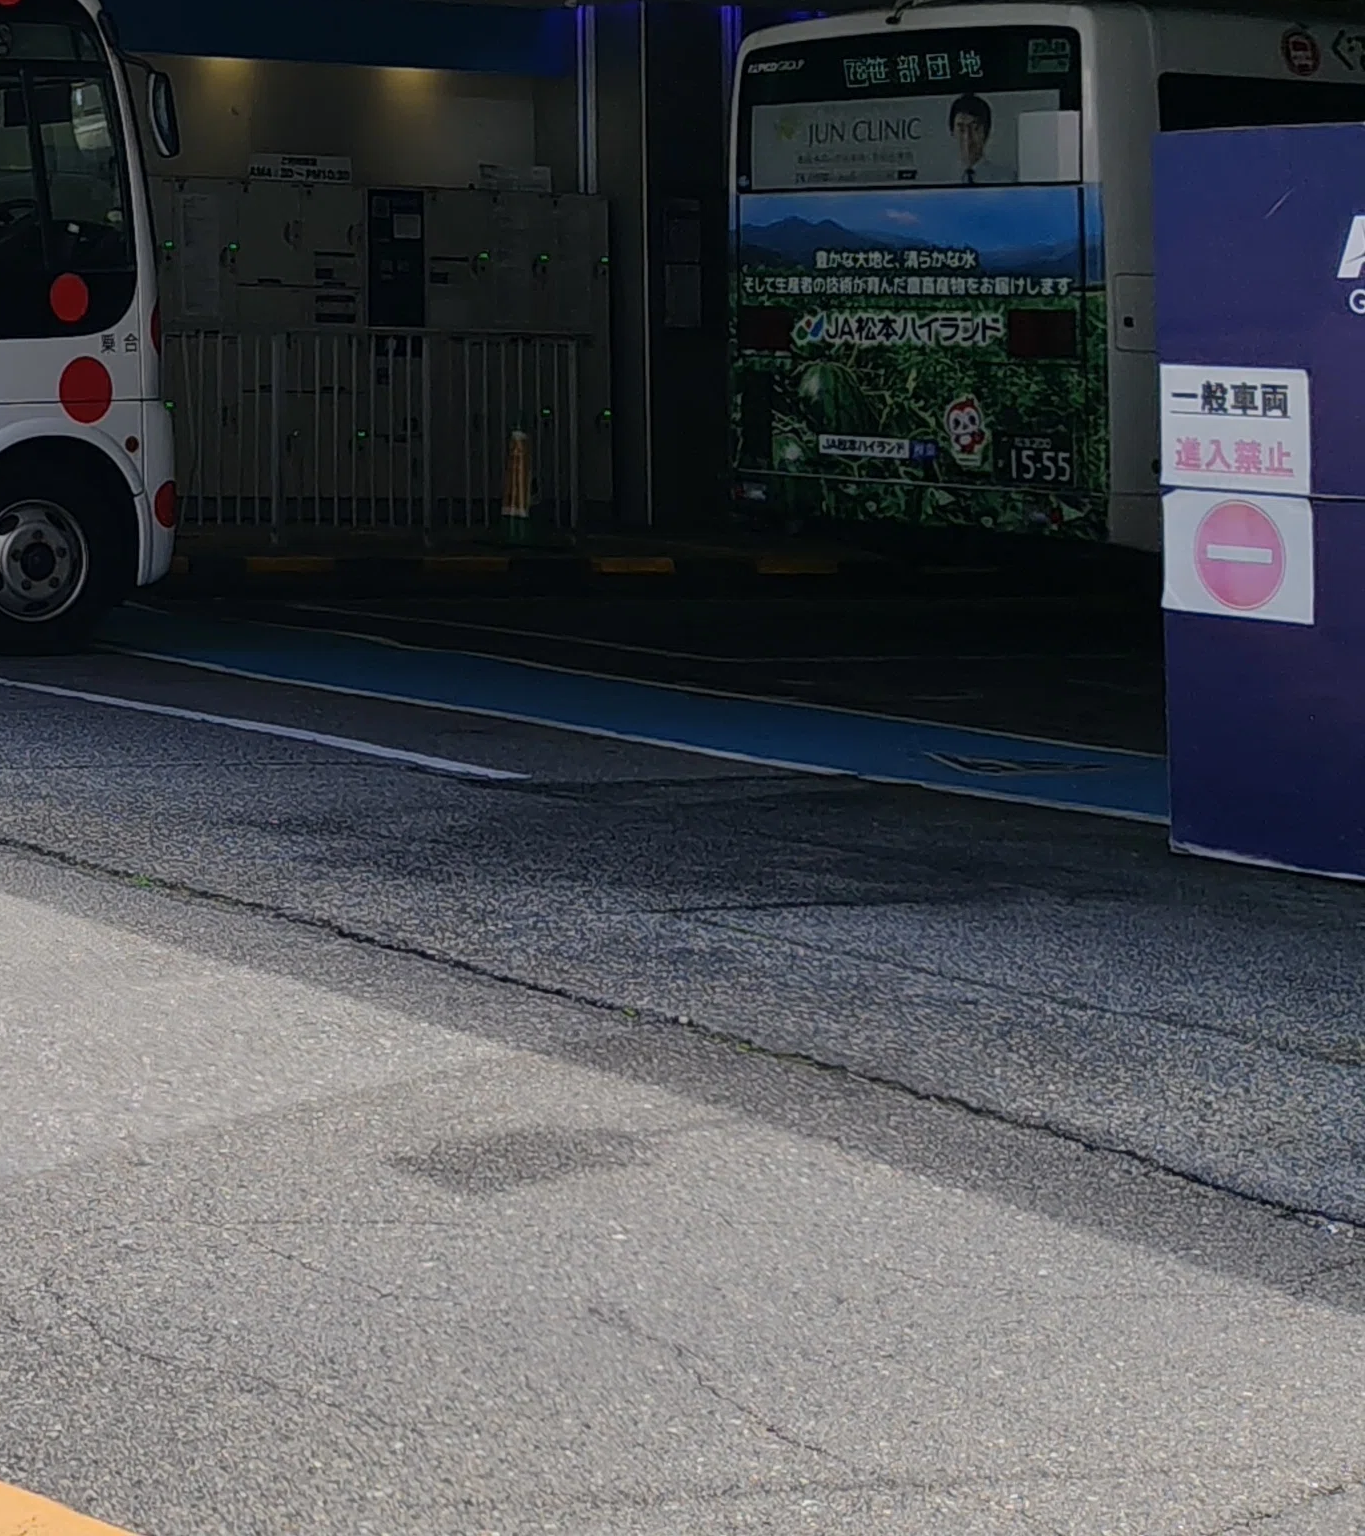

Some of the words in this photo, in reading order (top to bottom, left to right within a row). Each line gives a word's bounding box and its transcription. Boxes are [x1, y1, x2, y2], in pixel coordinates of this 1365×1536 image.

[808, 121, 846, 148] JUN
[852, 117, 922, 143] CLINIC
[825, 314, 1002, 343] JA松本ハイランド
[1171, 380, 1289, 416] 一般車両
[1175, 436, 1294, 475] 進入禁止
